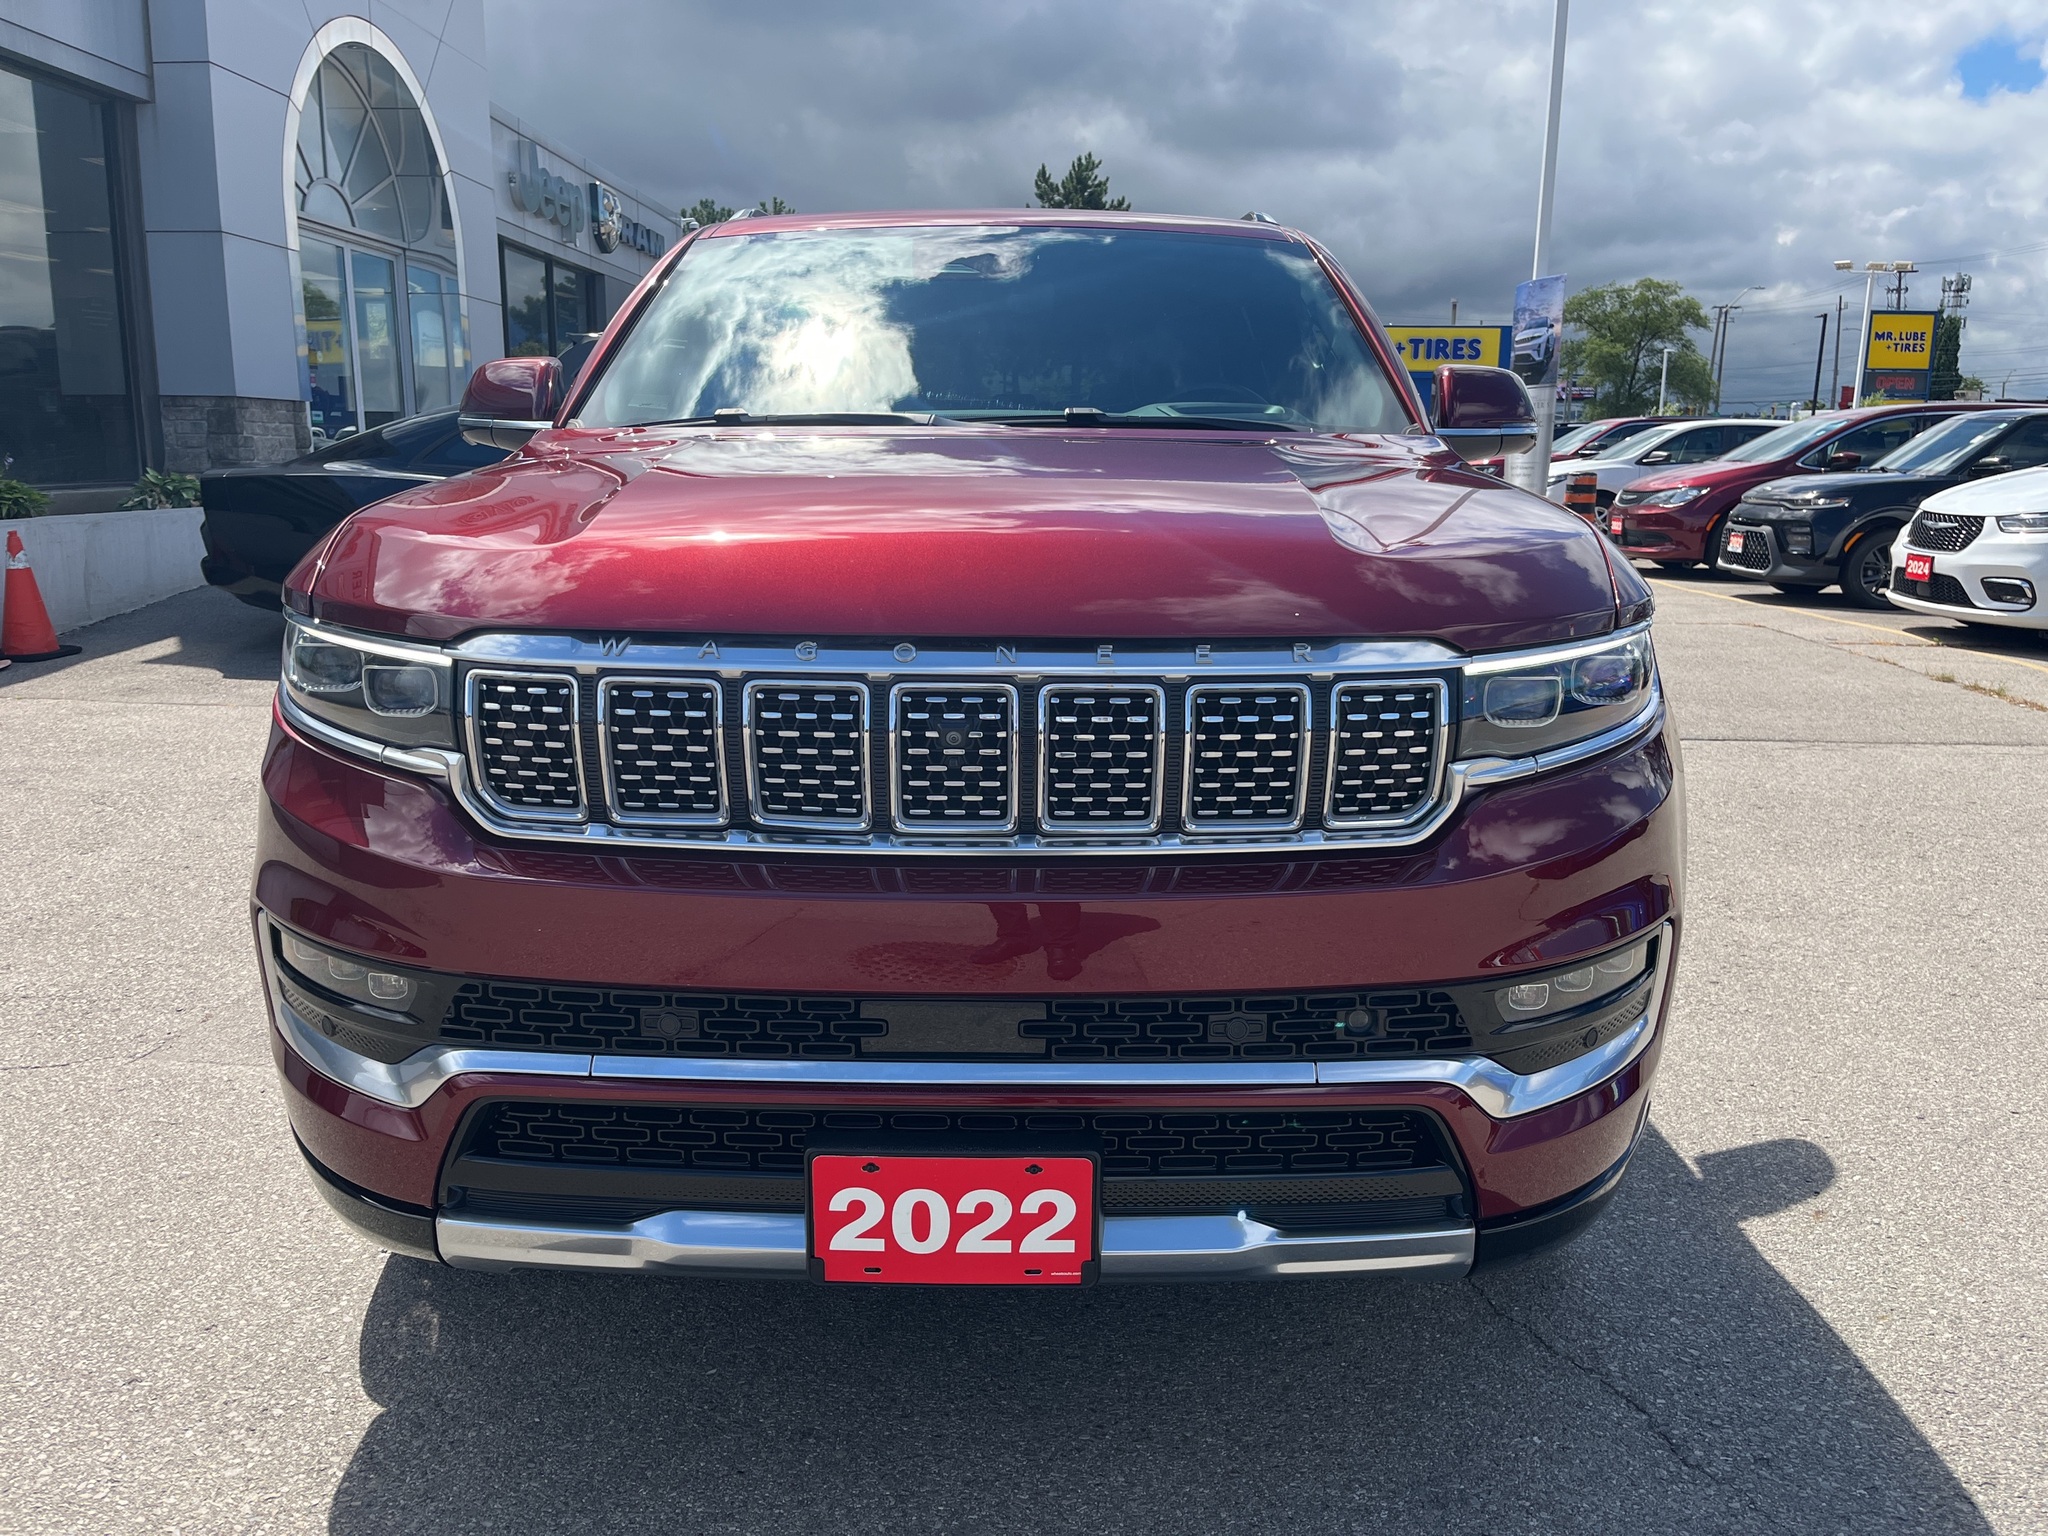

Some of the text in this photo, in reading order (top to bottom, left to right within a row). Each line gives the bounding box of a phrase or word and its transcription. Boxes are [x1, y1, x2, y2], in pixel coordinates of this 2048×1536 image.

[509, 140, 584, 245] Jeep
[620, 213, 664, 258] RAM
[1874, 331, 1926, 341] MR. LUBE
[1876, 376, 1915, 390] OPEN
[1907, 560, 1930, 576] 2024
[598, 635, 1313, 664] WAGONEER
[828, 1187, 1077, 1254] 2022
